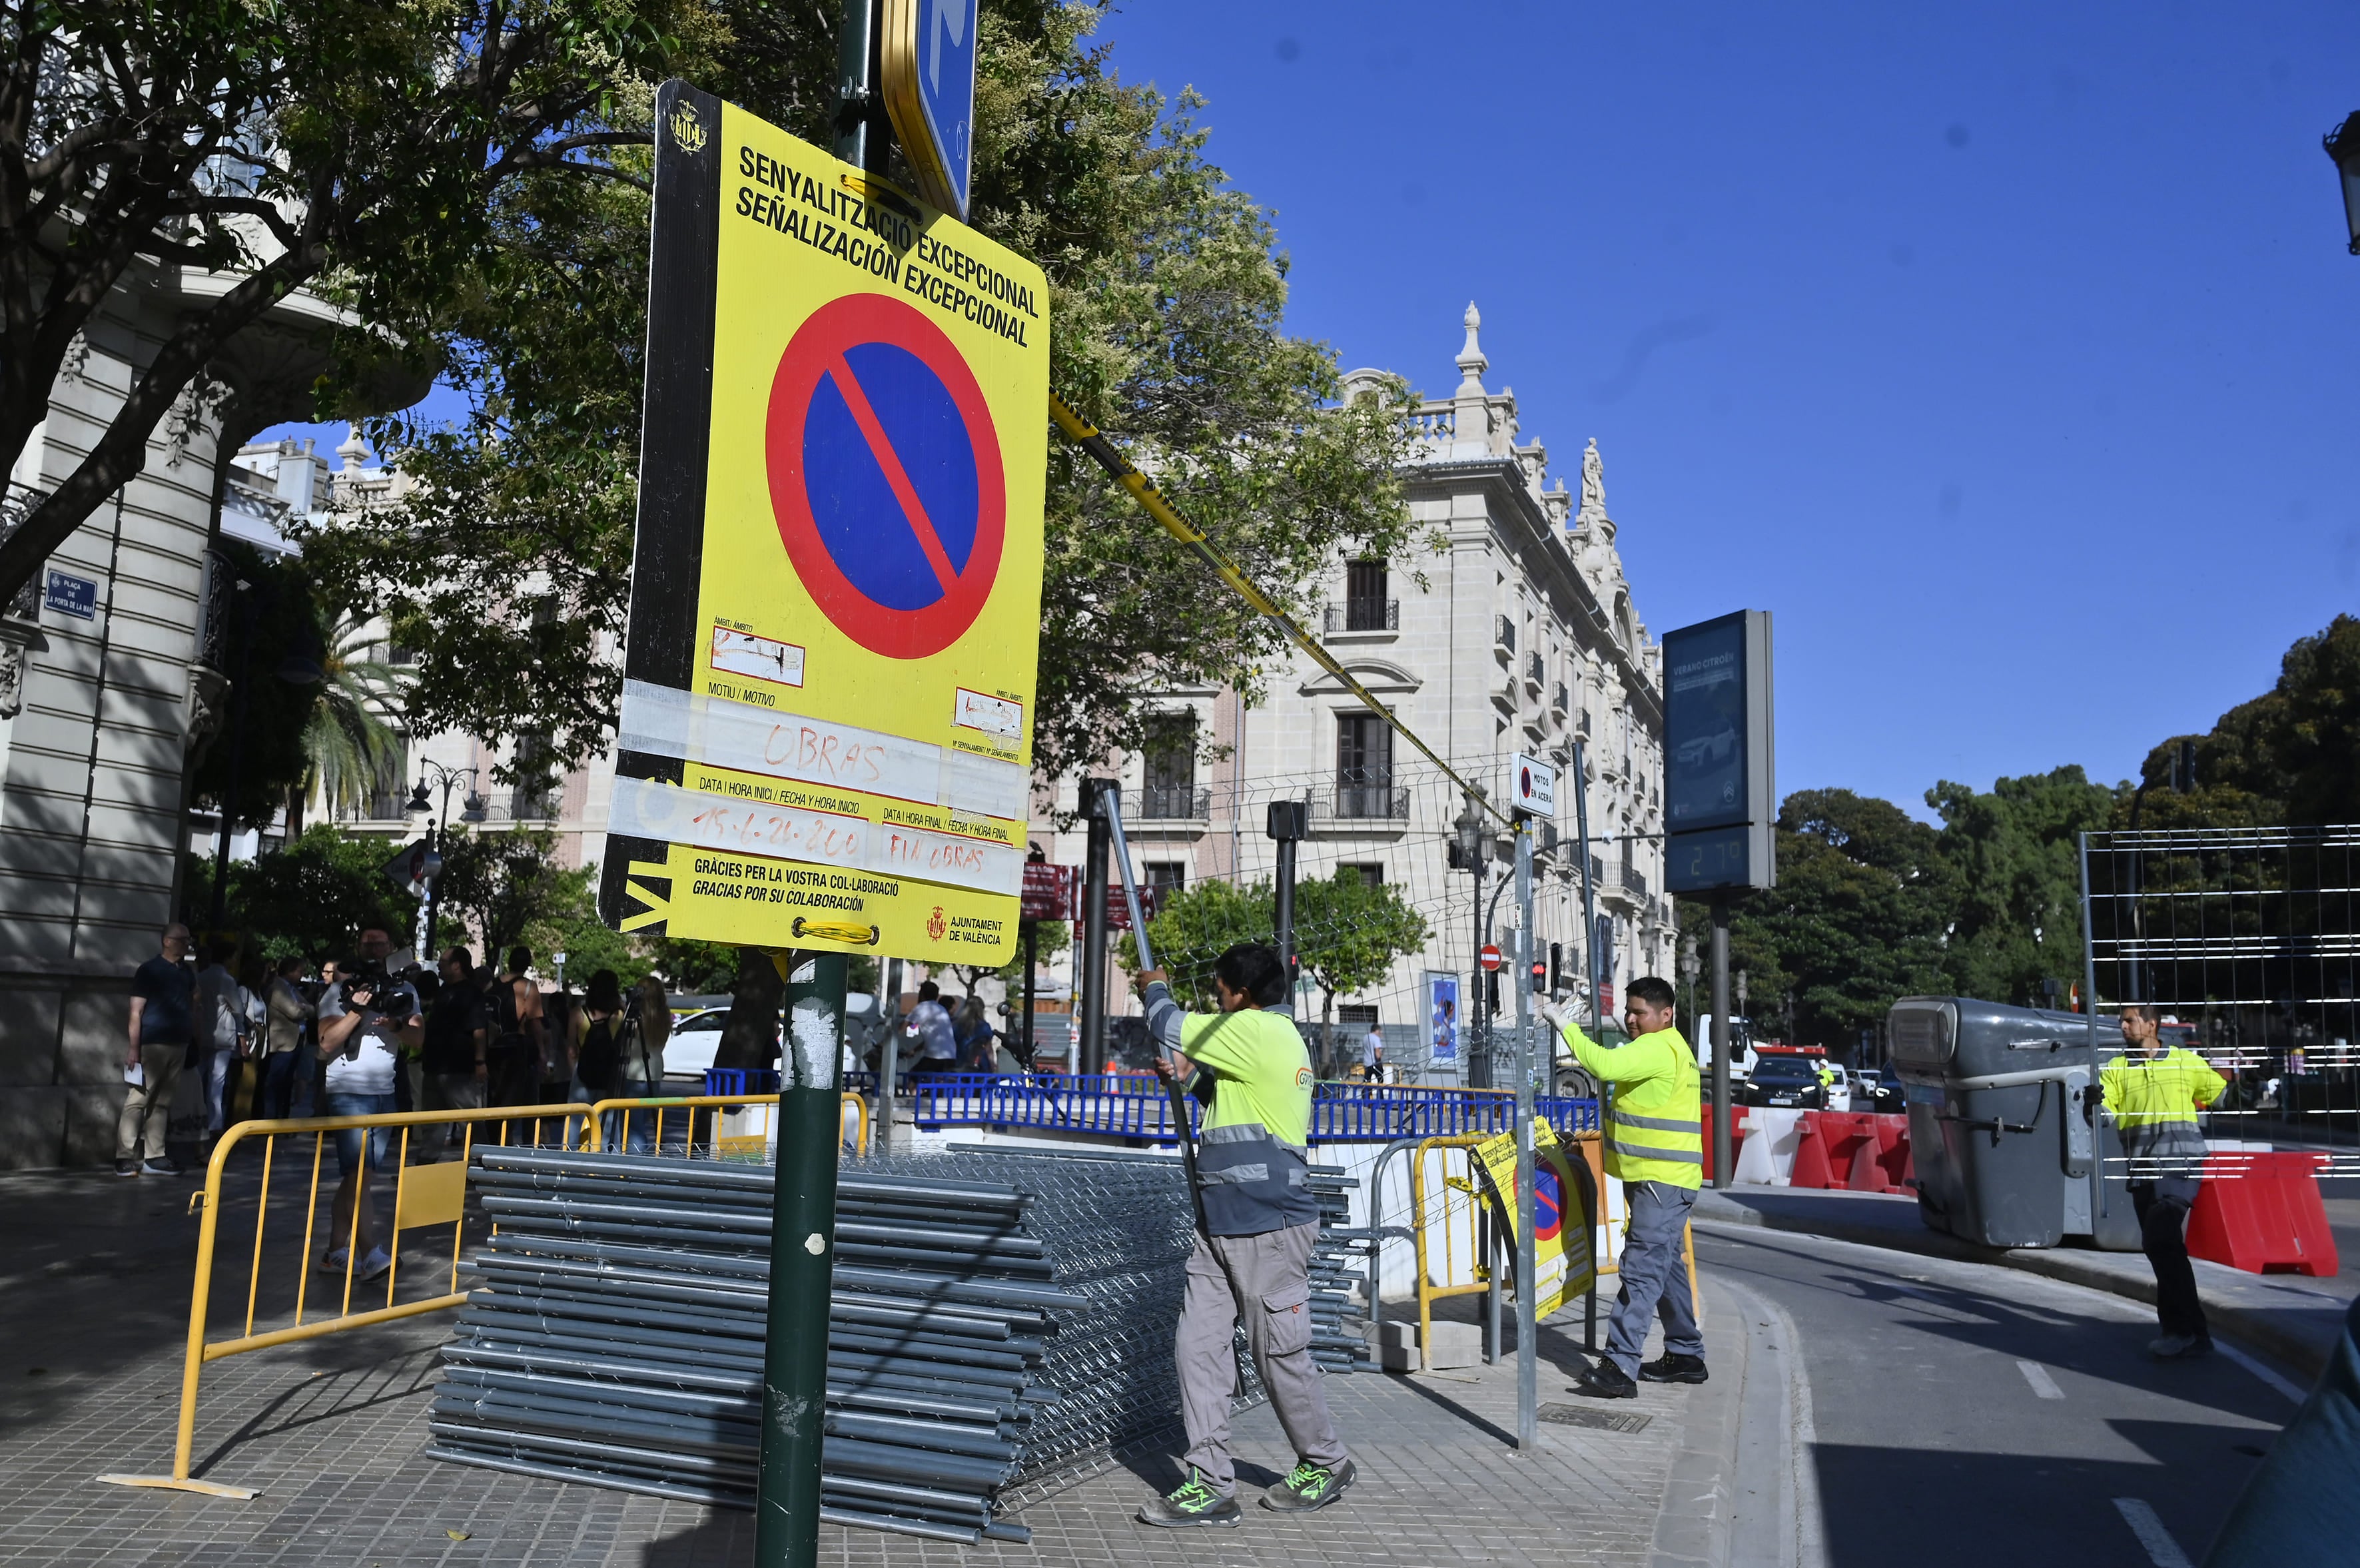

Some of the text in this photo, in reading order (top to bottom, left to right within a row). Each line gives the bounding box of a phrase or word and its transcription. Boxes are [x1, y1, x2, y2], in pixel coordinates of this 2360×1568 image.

[739, 146, 1039, 319] SENYALITZACIÓ EXCEPCIONAL
[735, 186, 1028, 348] SEÑALIZACIÓN EXCEPCIONAL
[63, 580, 81, 590] PLAÇA
[54, 597, 69, 607] PORTA
[69, 601, 75, 609] DE
[83, 605, 93, 613] MAR
[733, 619, 753, 633] ÁMBITO
[1673, 661, 1701, 676] VERANO
[708, 681, 775, 707] MOTIU / MOTIVO
[765, 724, 885, 782] OBRAS
[1534, 773, 1549, 787] MOTOS
[699, 777, 722, 793] DATA
[729, 782, 752, 797] HORA
[754, 786, 772, 801] INICI
[773, 789, 778, 801] /
[779, 790, 806, 805] FECHA
[807, 795, 815, 807] Y
[814, 796, 837, 810] HORA
[837, 800, 860, 814] INICIO
[1531, 788, 1552, 804] EN ACERA
[883, 808, 901, 820] DATA
[905, 811, 923, 827] HORA
[925, 815, 943, 830] FINAL
[943, 819, 947, 830] /
[947, 819, 968, 834] FECHA
[969, 823, 975, 834] Y
[975, 825, 991, 837] HORA
[992, 827, 1008, 841] FINAL
[889, 833, 984, 873] FIN OBRAS
[695, 857, 899, 897] GRÀCIES PER LA VOSTRA COL·LABORACIÓ
[693, 880, 865, 913] GRACIAS POR SU COLABORACIÓN
[951, 916, 1002, 931] AJUNTAMENT
[949, 930, 1001, 945] DE VALÈNCIA
